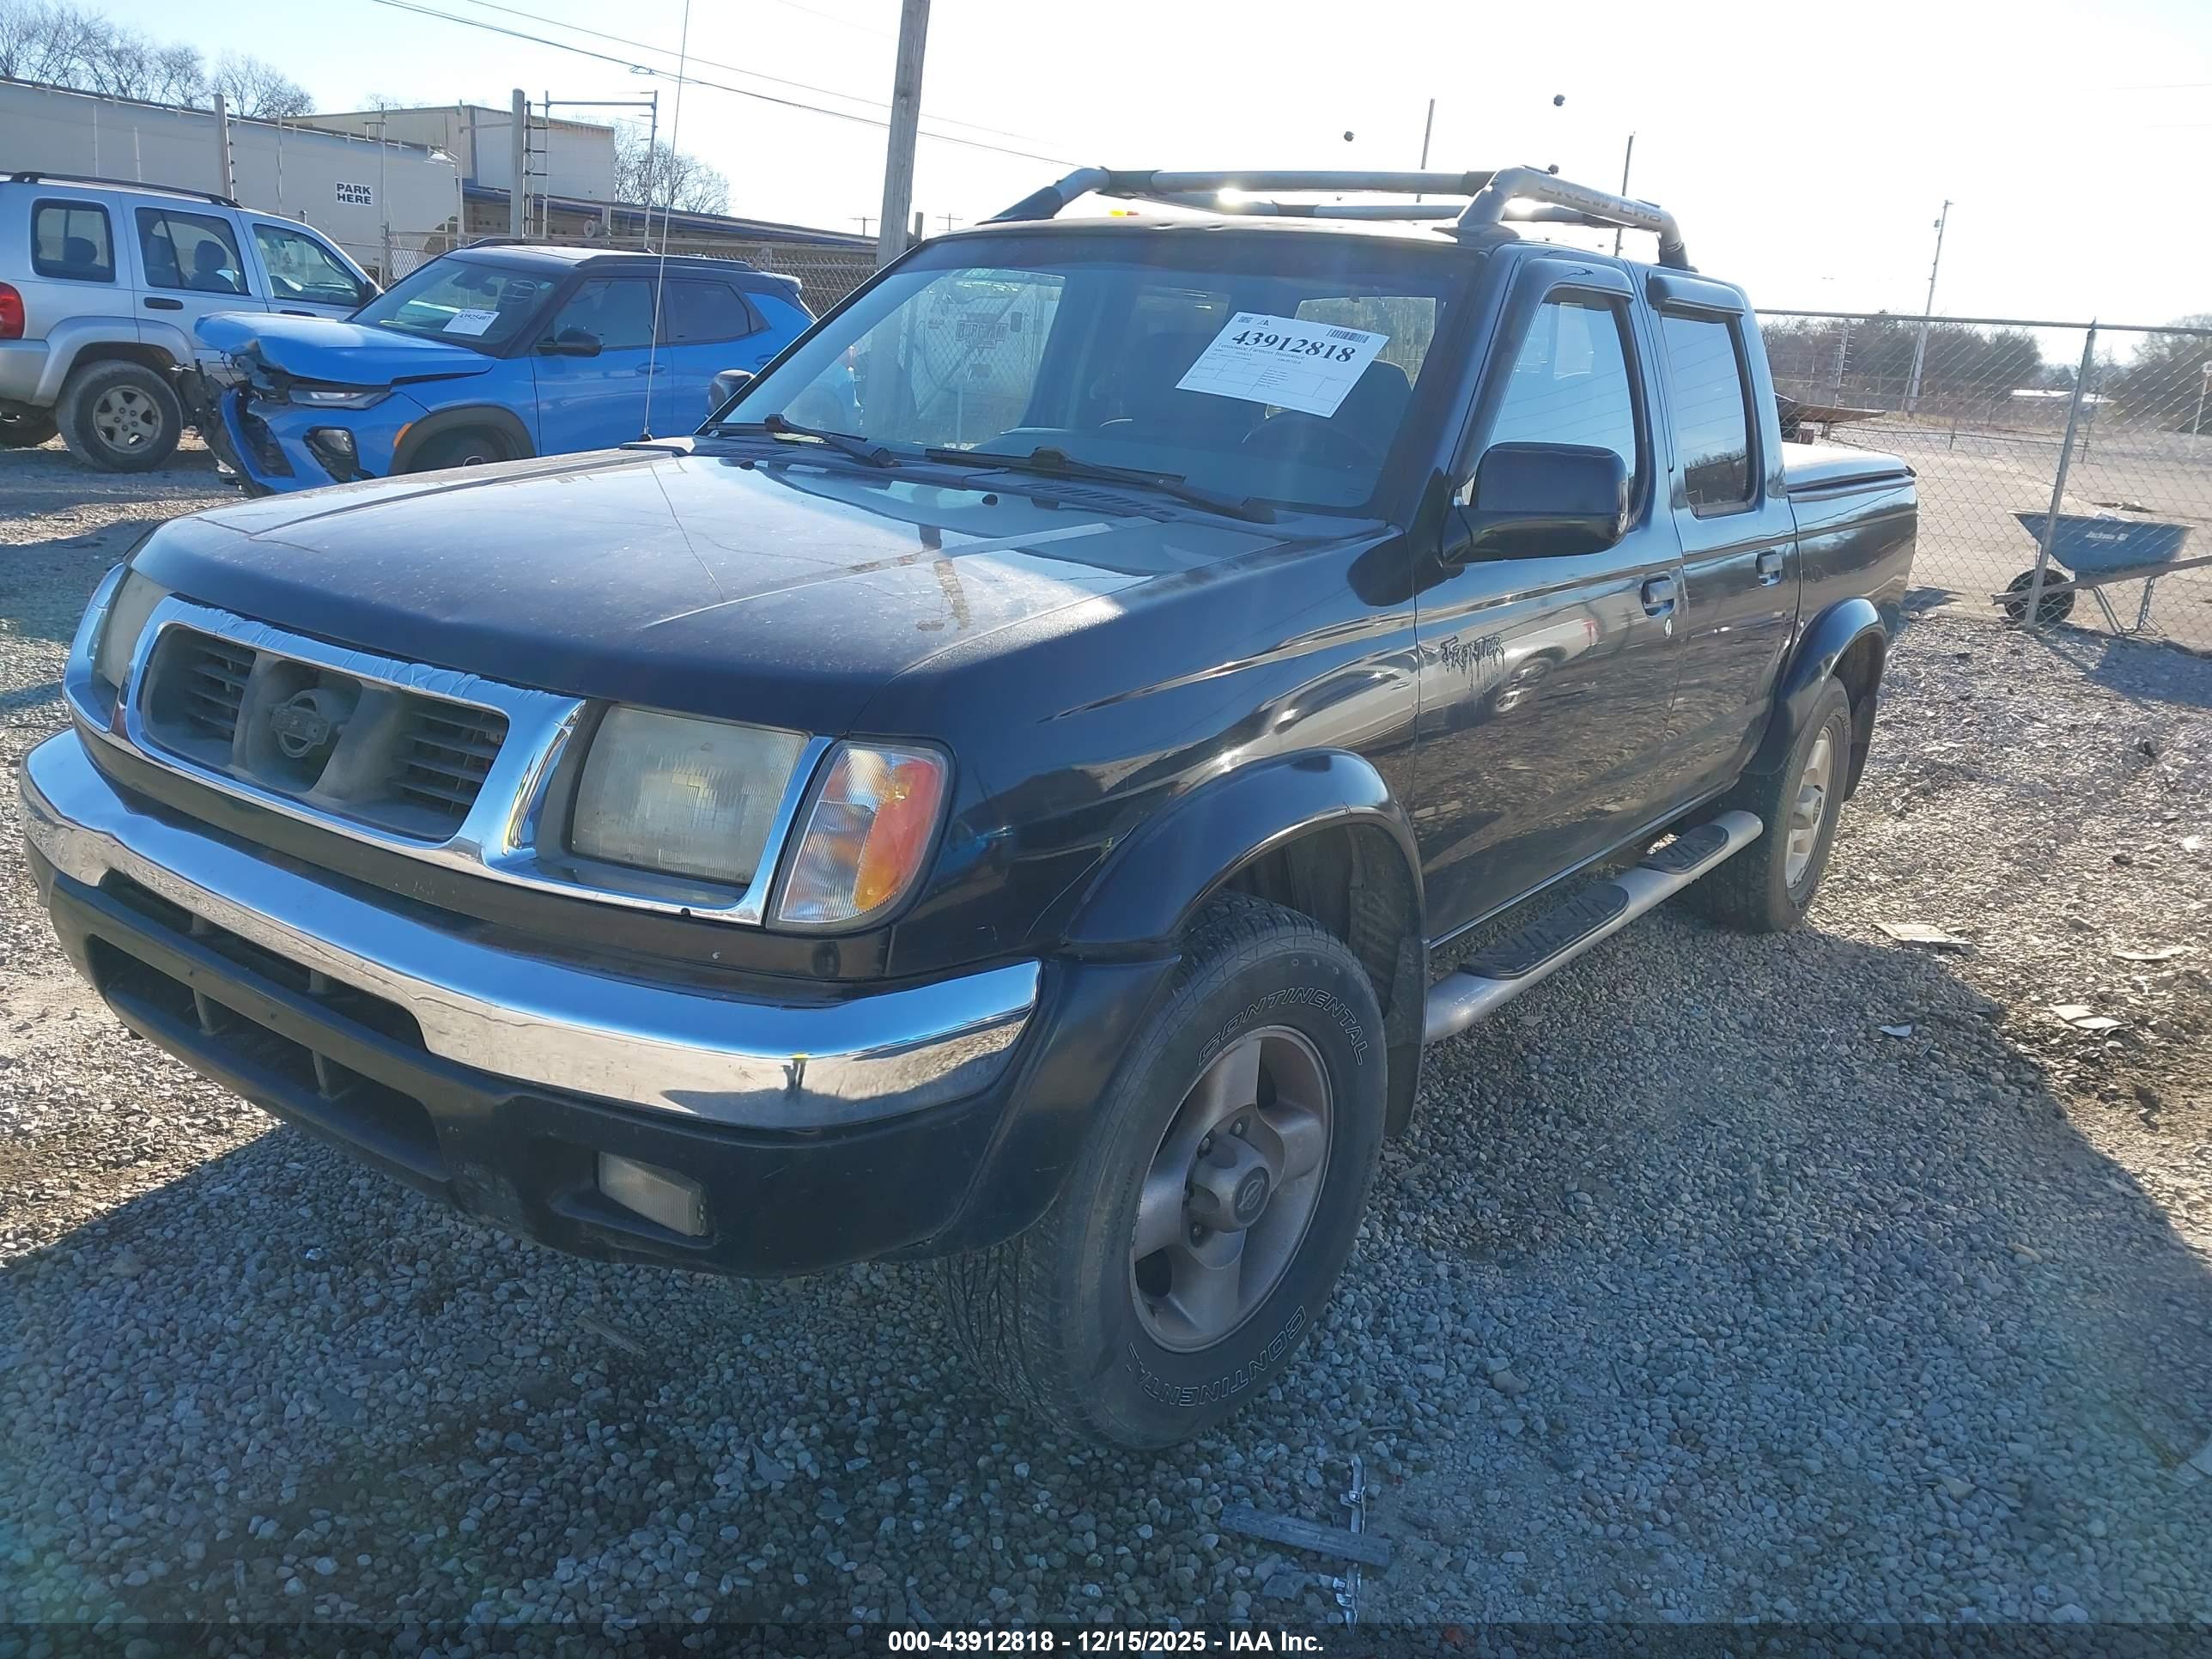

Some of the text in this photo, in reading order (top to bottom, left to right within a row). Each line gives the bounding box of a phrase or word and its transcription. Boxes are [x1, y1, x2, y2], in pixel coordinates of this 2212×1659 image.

[336, 183, 372, 196] PARK
[337, 192, 372, 205] HERE
[1231, 330, 1356, 362] 43912818
[1198, 988, 1368, 1066] CONTINENTAL
